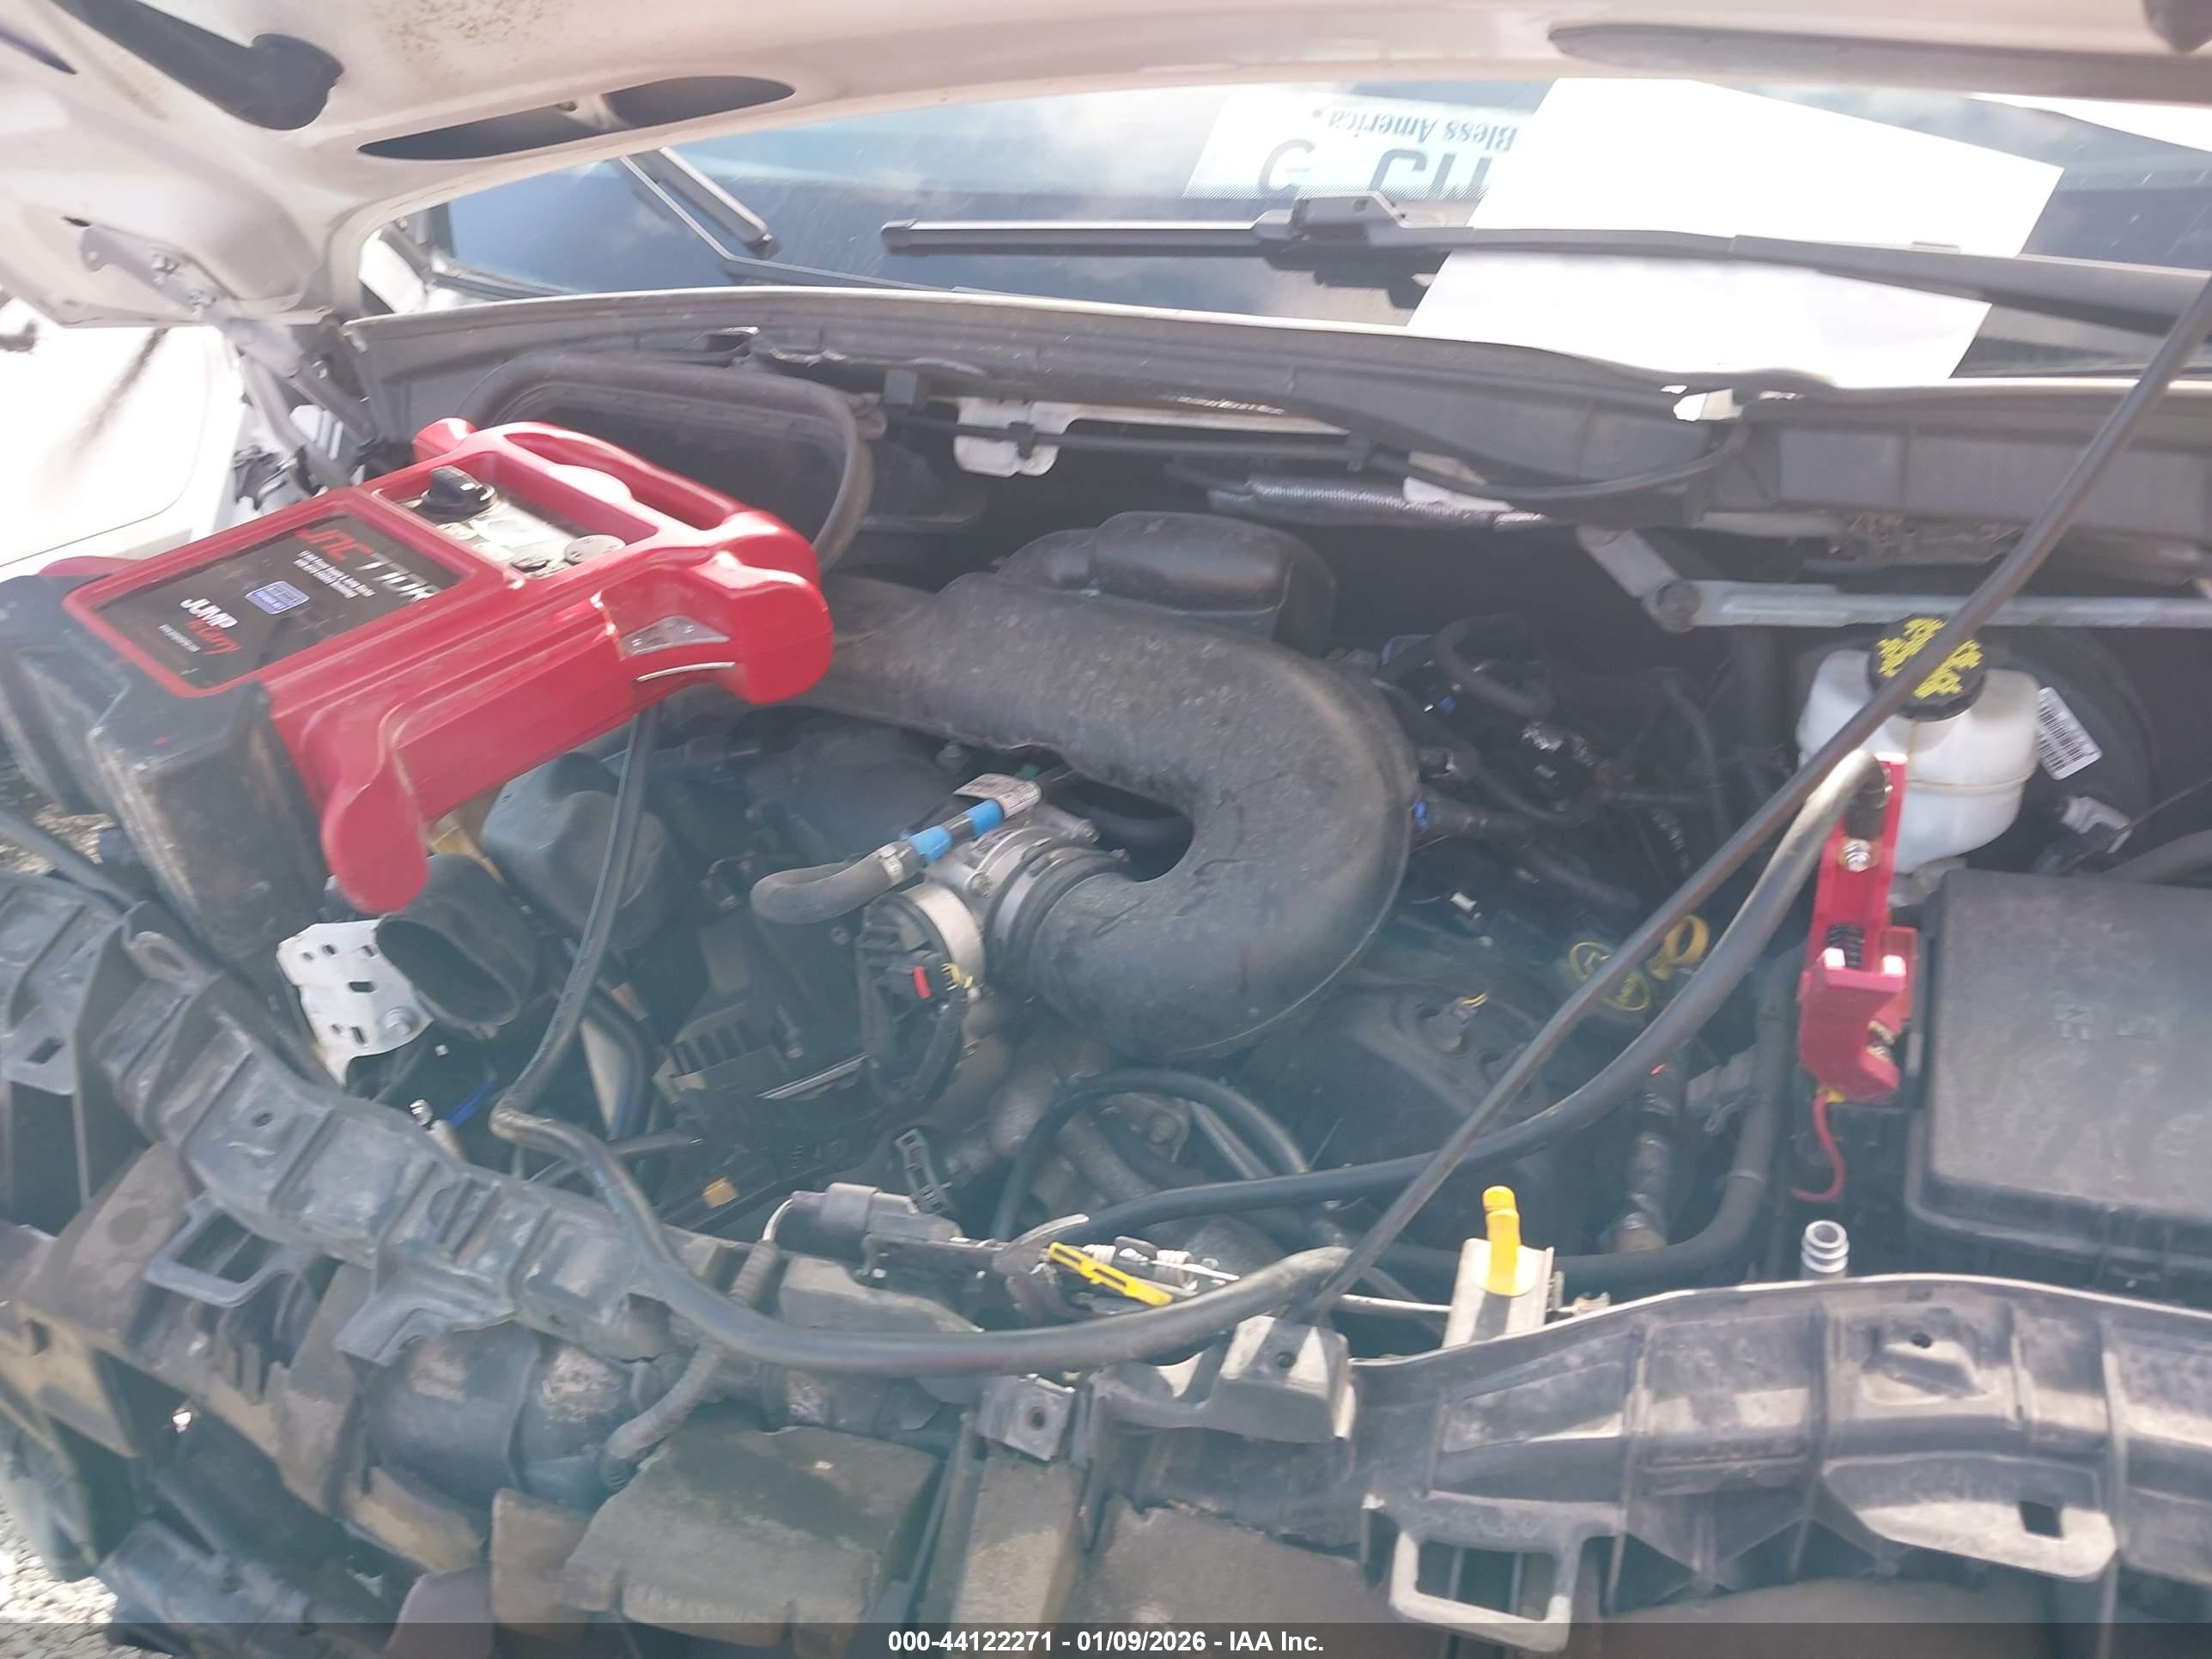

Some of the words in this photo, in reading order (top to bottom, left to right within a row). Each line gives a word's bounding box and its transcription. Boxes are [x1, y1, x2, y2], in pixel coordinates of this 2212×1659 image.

[1328, 108, 1439, 144] America
[1443, 119, 1518, 152] Bless
[179, 598, 238, 629] JUMP
